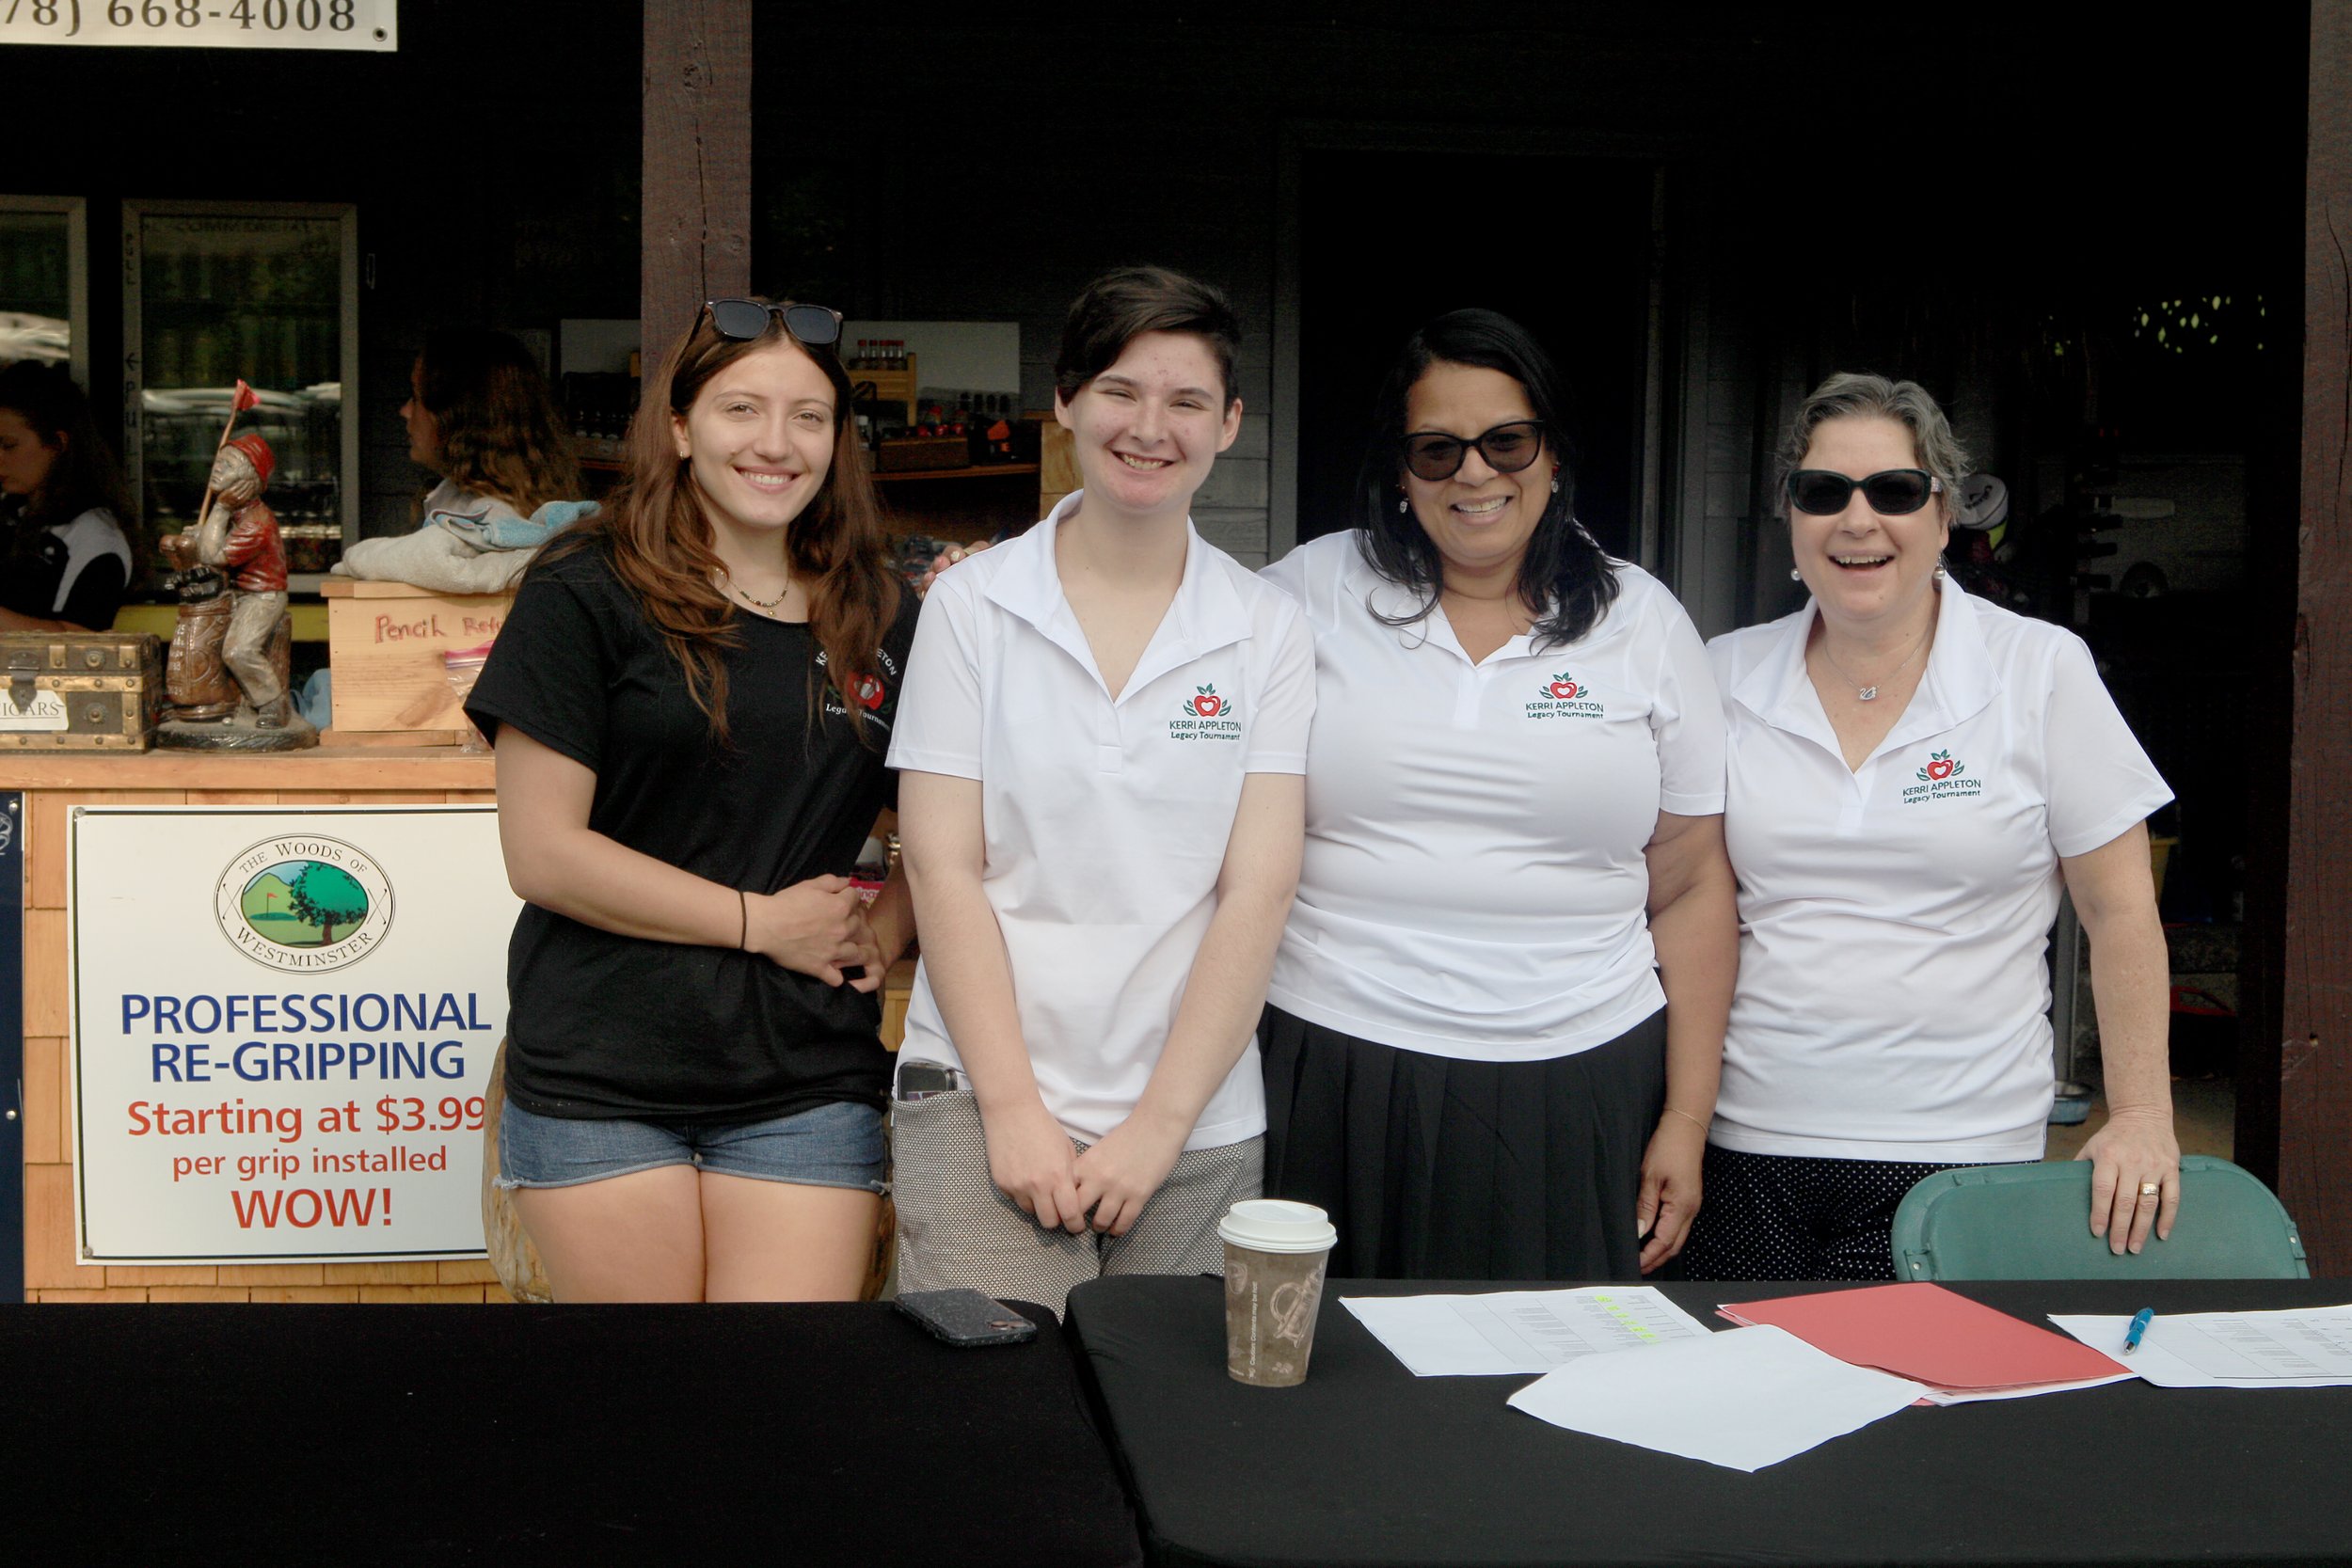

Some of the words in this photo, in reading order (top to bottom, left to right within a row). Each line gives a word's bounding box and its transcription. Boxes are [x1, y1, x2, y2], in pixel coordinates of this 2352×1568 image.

[106, 0, 356, 31] 668-4008
[826, 704, 847, 716] Lega
[1526, 702, 1552, 711] KERRI
[1555, 702, 1604, 712] APPLETON
[1557, 710, 1603, 720] Tournament
[1169, 721, 1196, 730] KERRI
[1199, 721, 1241, 732] APPLETON
[1170, 732, 1198, 740] Legacy
[1200, 731, 1240, 740] Tournament
[1902, 784, 1929, 797] KERRI
[1931, 779, 1981, 792] APPLETON
[1903, 795, 1931, 804] Legacy
[1931, 790, 1980, 800] Tournament
[239, 851, 268, 875] THE
[275, 842, 342, 862] WOODS
[349, 859, 368, 875] OF
[236, 927, 373, 967] WESTMINSTER
[121, 992, 492, 1035] PROFESSIONAL
[151, 1040, 465, 1083] RE-GRIPPING
[128, 1098, 302, 1143] Starting
[317, 1100, 361, 1133] at
[376, 1095, 485, 1135] $3.99
[173, 1155, 226, 1182] per
[237, 1148, 300, 1181] grip
[312, 1145, 447, 1174] installed
[230, 1187, 391, 1228] WOW!
